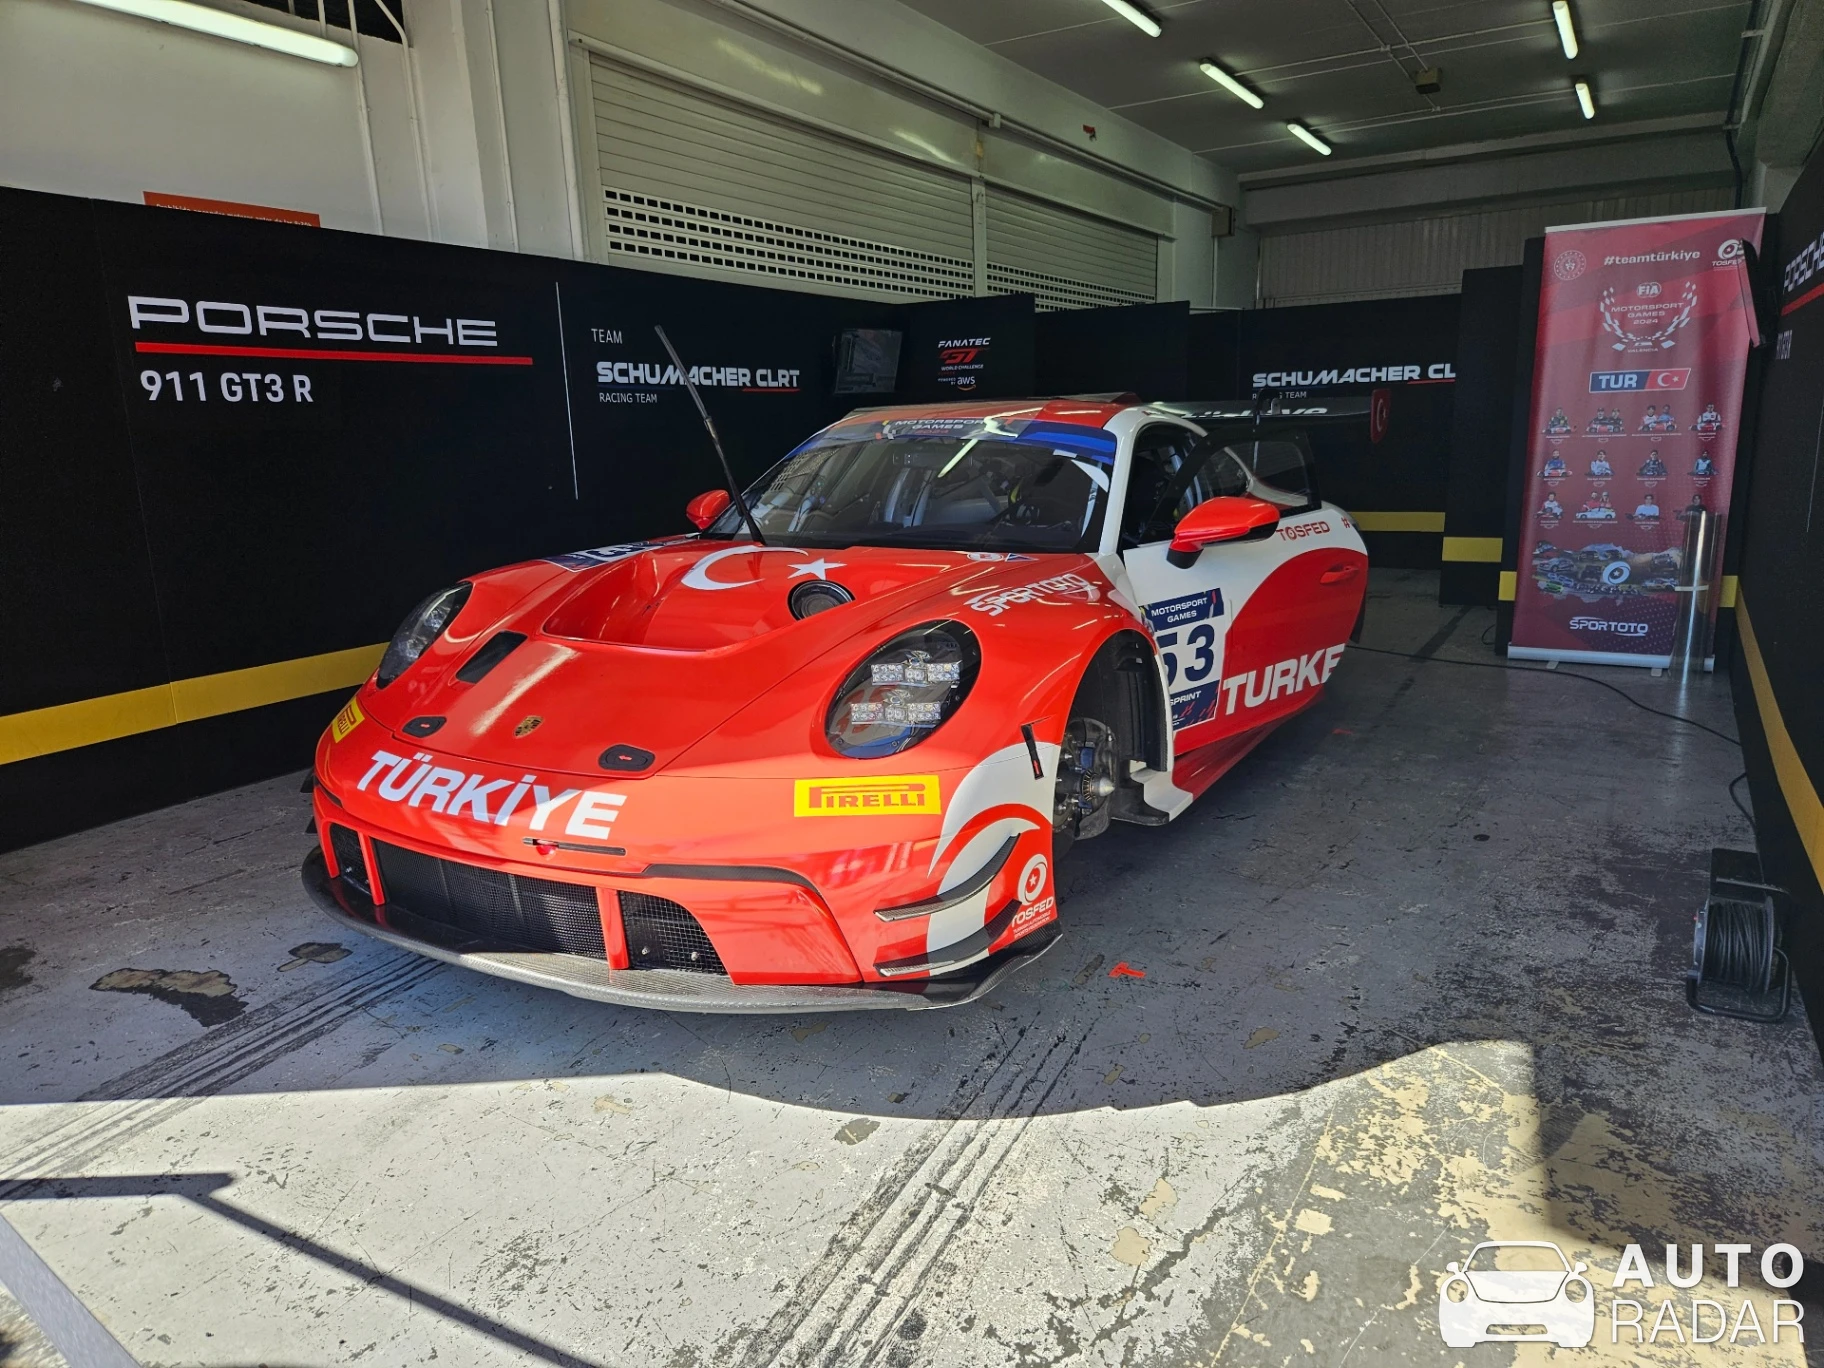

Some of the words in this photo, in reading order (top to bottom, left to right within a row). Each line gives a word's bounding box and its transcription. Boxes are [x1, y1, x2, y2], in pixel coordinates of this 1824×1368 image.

[1603, 250, 1700, 266] #teamtürkiye
[1611, 302, 1684, 313] MOTORSPORT
[1627, 310, 1666, 318] GAMES
[128, 295, 498, 347] PORSCHE
[591, 328, 623, 344] TEAM
[938, 337, 991, 348] FANATEC
[596, 361, 751, 387] SCHUMACHER
[756, 369, 800, 387] CLRT
[957, 376, 975, 385] aws
[1252, 365, 1421, 388] SCHUMACHER
[1598, 373, 1638, 389] TUR
[140, 370, 208, 402] 911
[219, 371, 285, 403] GT3
[293, 374, 314, 403] R
[599, 392, 633, 403] RACING
[635, 393, 657, 403] TEAM
[1285, 391, 1307, 399] TEAM
[1275, 520, 1330, 541] TOSFED
[1151, 597, 1208, 617] MOTORSPORT
[1167, 610, 1197, 623] GAMES
[356, 750, 628, 840] TÜRKİYE
[808, 783, 926, 809] PIRELLI
[1011, 896, 1054, 928] TOSFED
